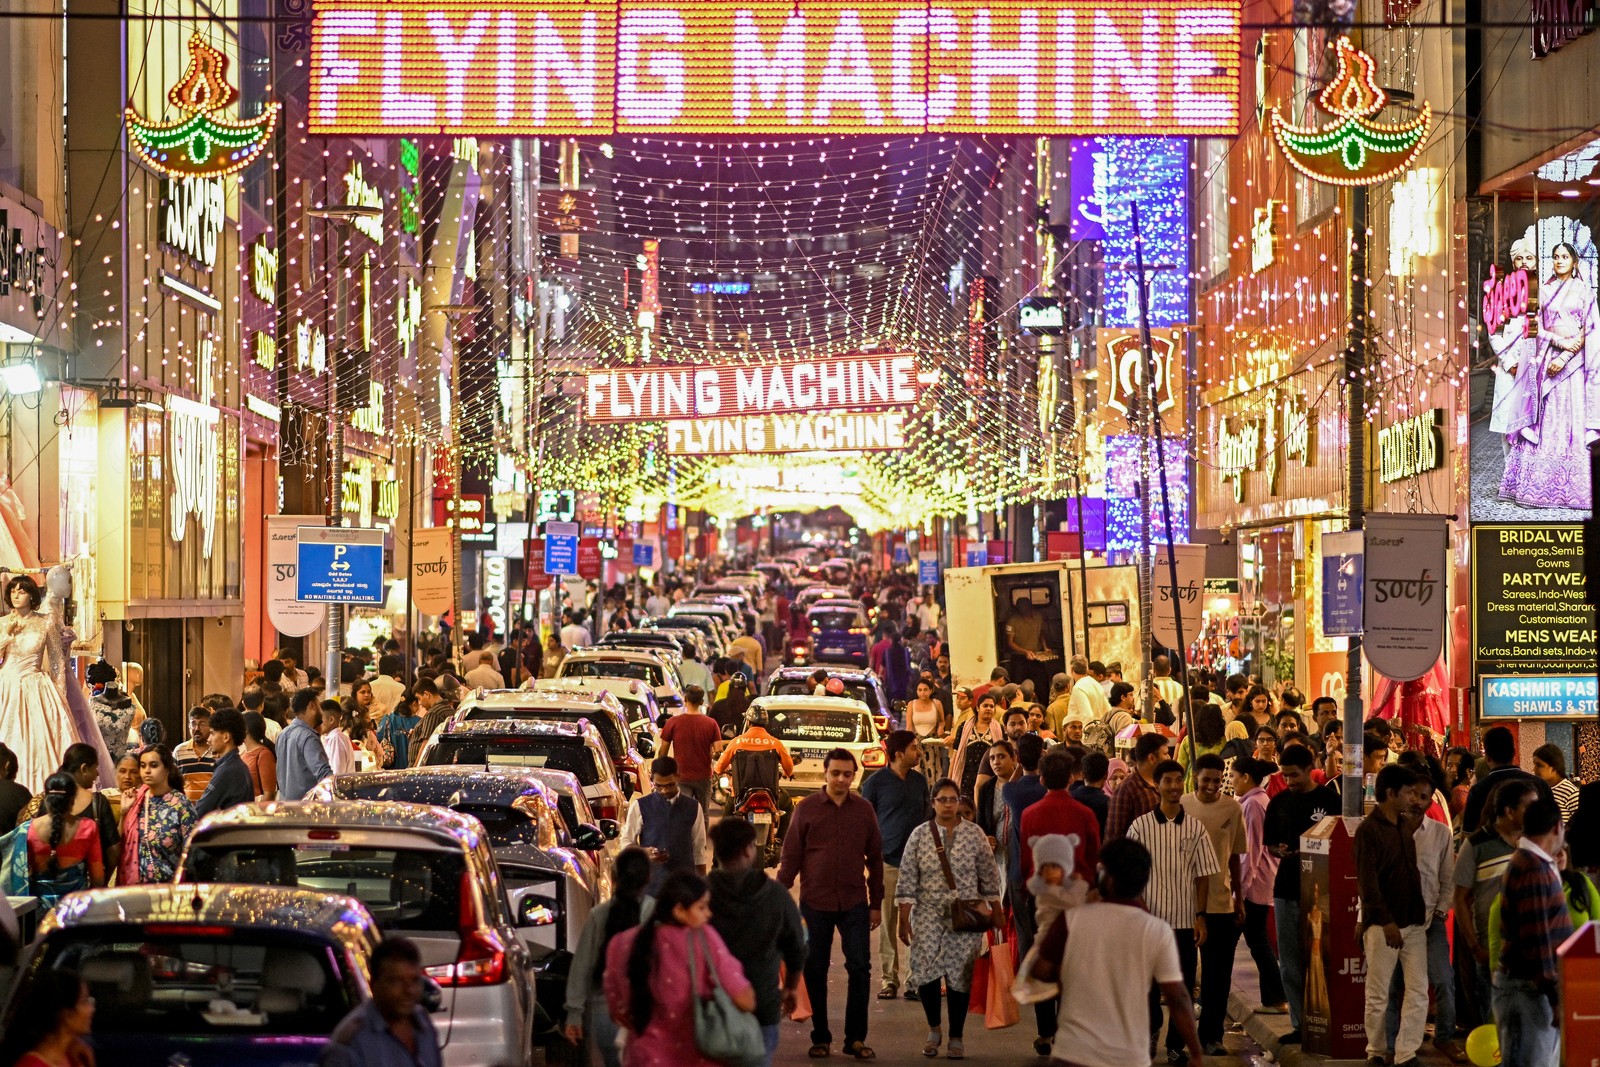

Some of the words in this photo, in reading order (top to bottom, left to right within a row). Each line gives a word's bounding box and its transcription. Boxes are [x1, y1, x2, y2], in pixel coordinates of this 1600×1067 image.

[320, 10, 685, 126] FLYING
[732, 9, 1234, 126] MACHINE
[587, 370, 722, 417] FLYING
[736, 358, 916, 411] MACHINE
[668, 419, 766, 451] FLYING
[774, 415, 904, 450] MACHINE
[1500, 530, 1554, 543] BRIDAL
[335, 545, 347, 560] P
[413, 555, 449, 577] soch
[1536, 558, 1570, 568] Gowns
[1503, 573, 1552, 586] PARTY
[1157, 580, 1200, 604] sch
[1369, 568, 1439, 606] soch
[1487, 602, 1515, 612] Dress
[1519, 614, 1587, 624] Customisation
[1505, 630, 1550, 643] MENS
[1479, 646, 1541, 657] Kurtas,Bandi
[1487, 681, 1562, 697] KASHMIR
[1513, 701, 1563, 713] SHAWLS
[1566, 700, 1575, 712] &
[735, 737, 776, 746] SWIGGY
